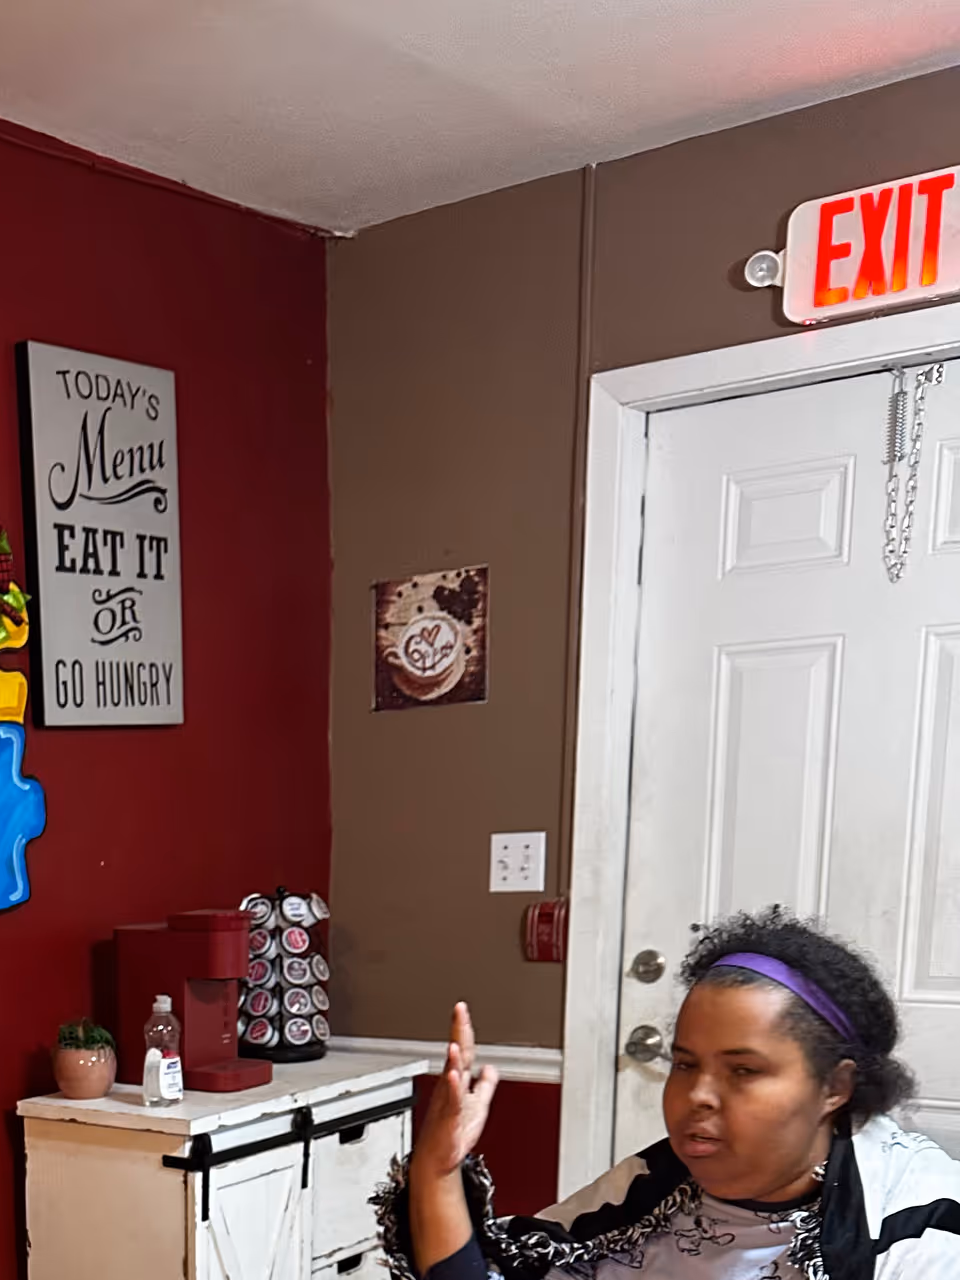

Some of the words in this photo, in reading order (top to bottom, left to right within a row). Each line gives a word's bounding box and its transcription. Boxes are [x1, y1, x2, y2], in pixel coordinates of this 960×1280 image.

[813, 173, 955, 308] EXIT
[56, 370, 160, 421] TODAY'S
[48, 406, 166, 511] Menu
[53, 523, 125, 578] EAT
[135, 534, 168, 580] IT
[93, 597, 140, 635] OR
[55, 659, 83, 708] GO
[96, 661, 173, 708] HUNGRY
